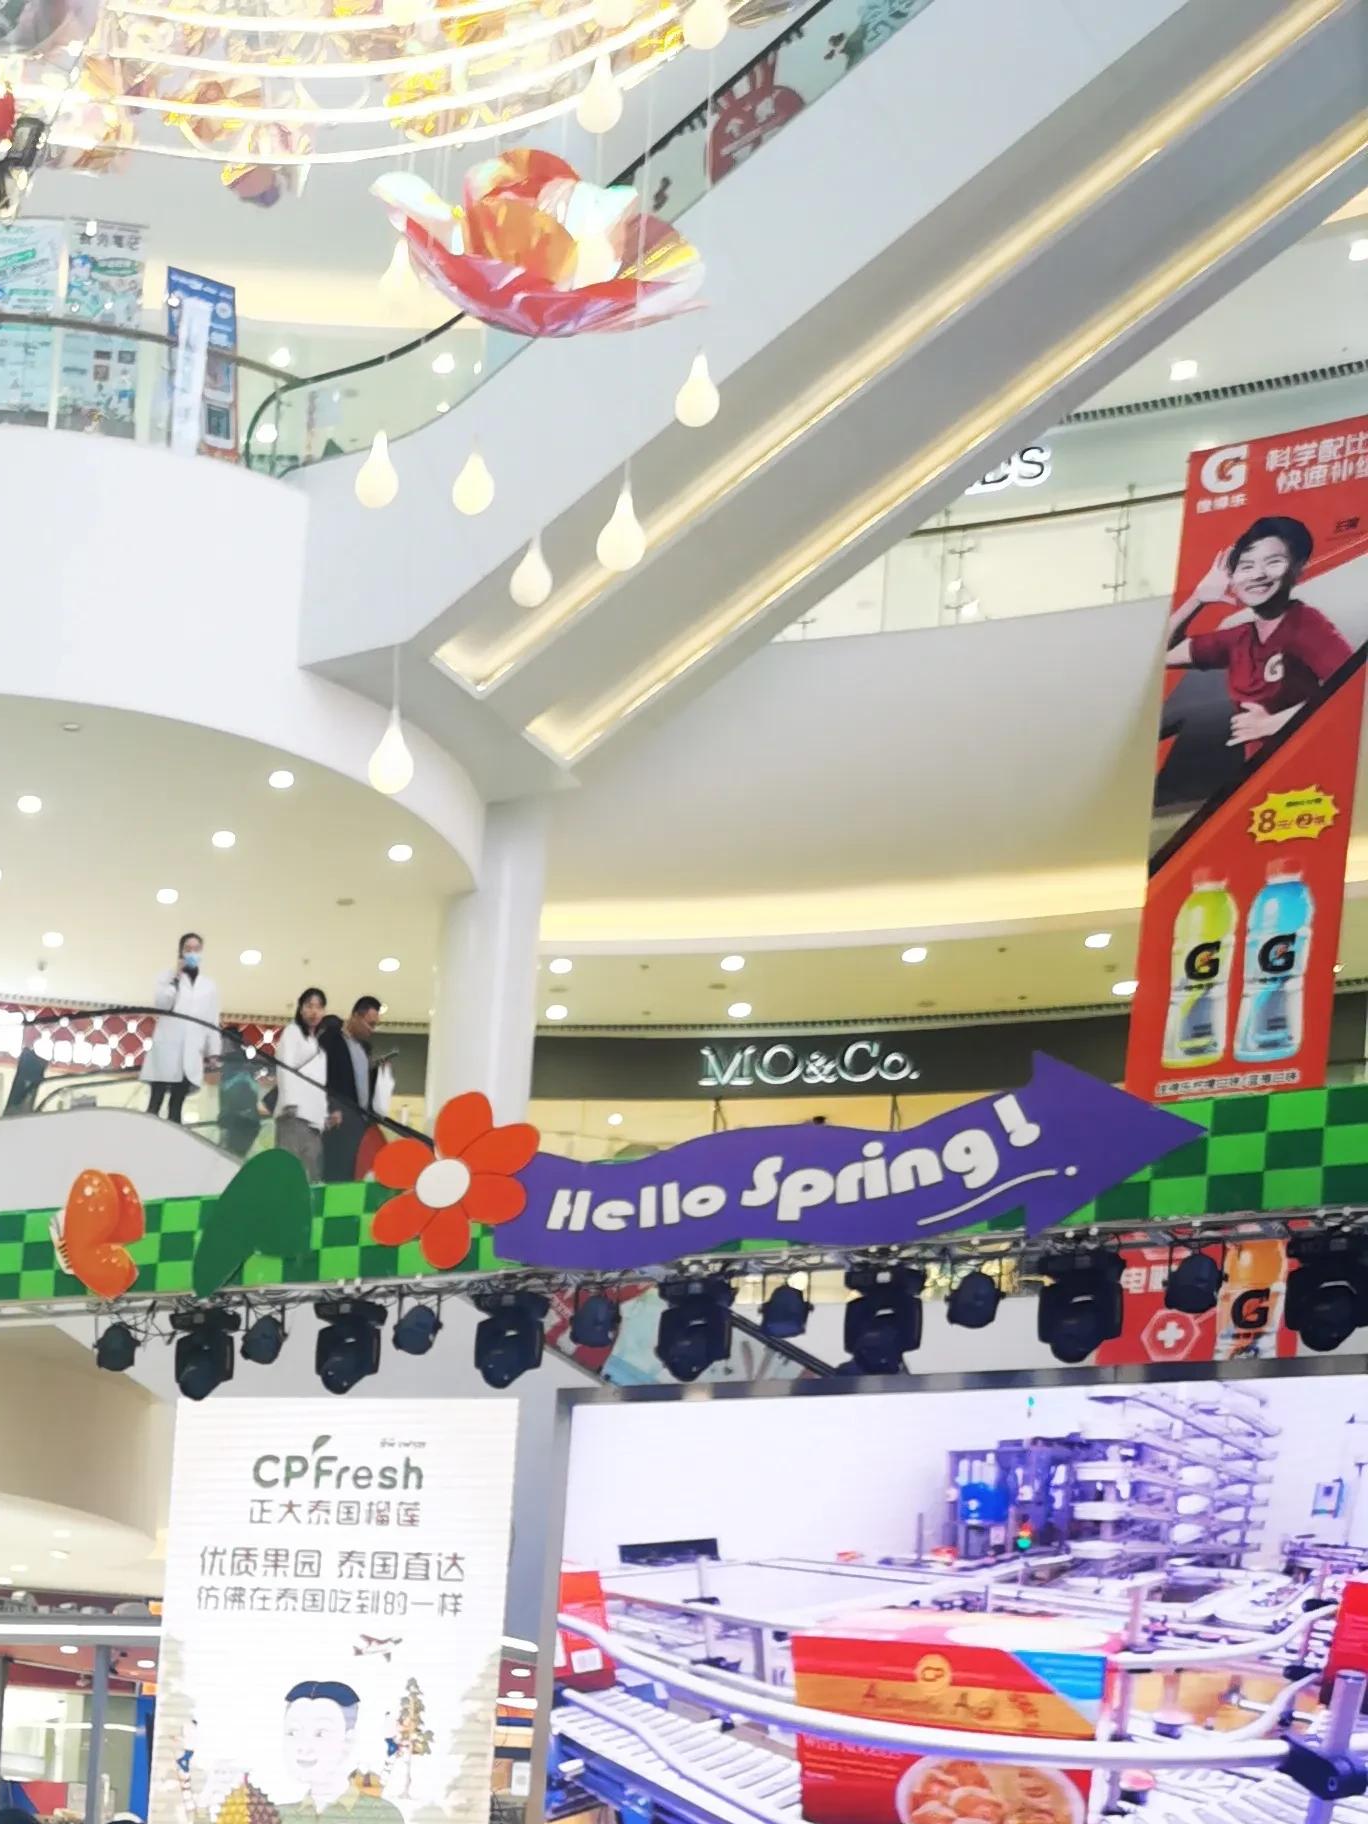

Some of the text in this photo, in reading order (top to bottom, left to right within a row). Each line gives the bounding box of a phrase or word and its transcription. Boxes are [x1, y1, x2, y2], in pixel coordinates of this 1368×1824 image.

[1200, 445, 1248, 494] G
[1185, 940, 1222, 982] G
[1258, 933, 1297, 974] G
[699, 1041, 920, 1086] MO&Co.
[545, 1092, 1042, 1234] Hello Spring!
[1231, 1288, 1271, 1329] G
[249, 1498, 421, 1528] 正大泰国榴莲
[199, 1545, 466, 1583] 优质果园 泰国直达
[196, 1584, 464, 1618] 仿佛在泰国吃到的一样
